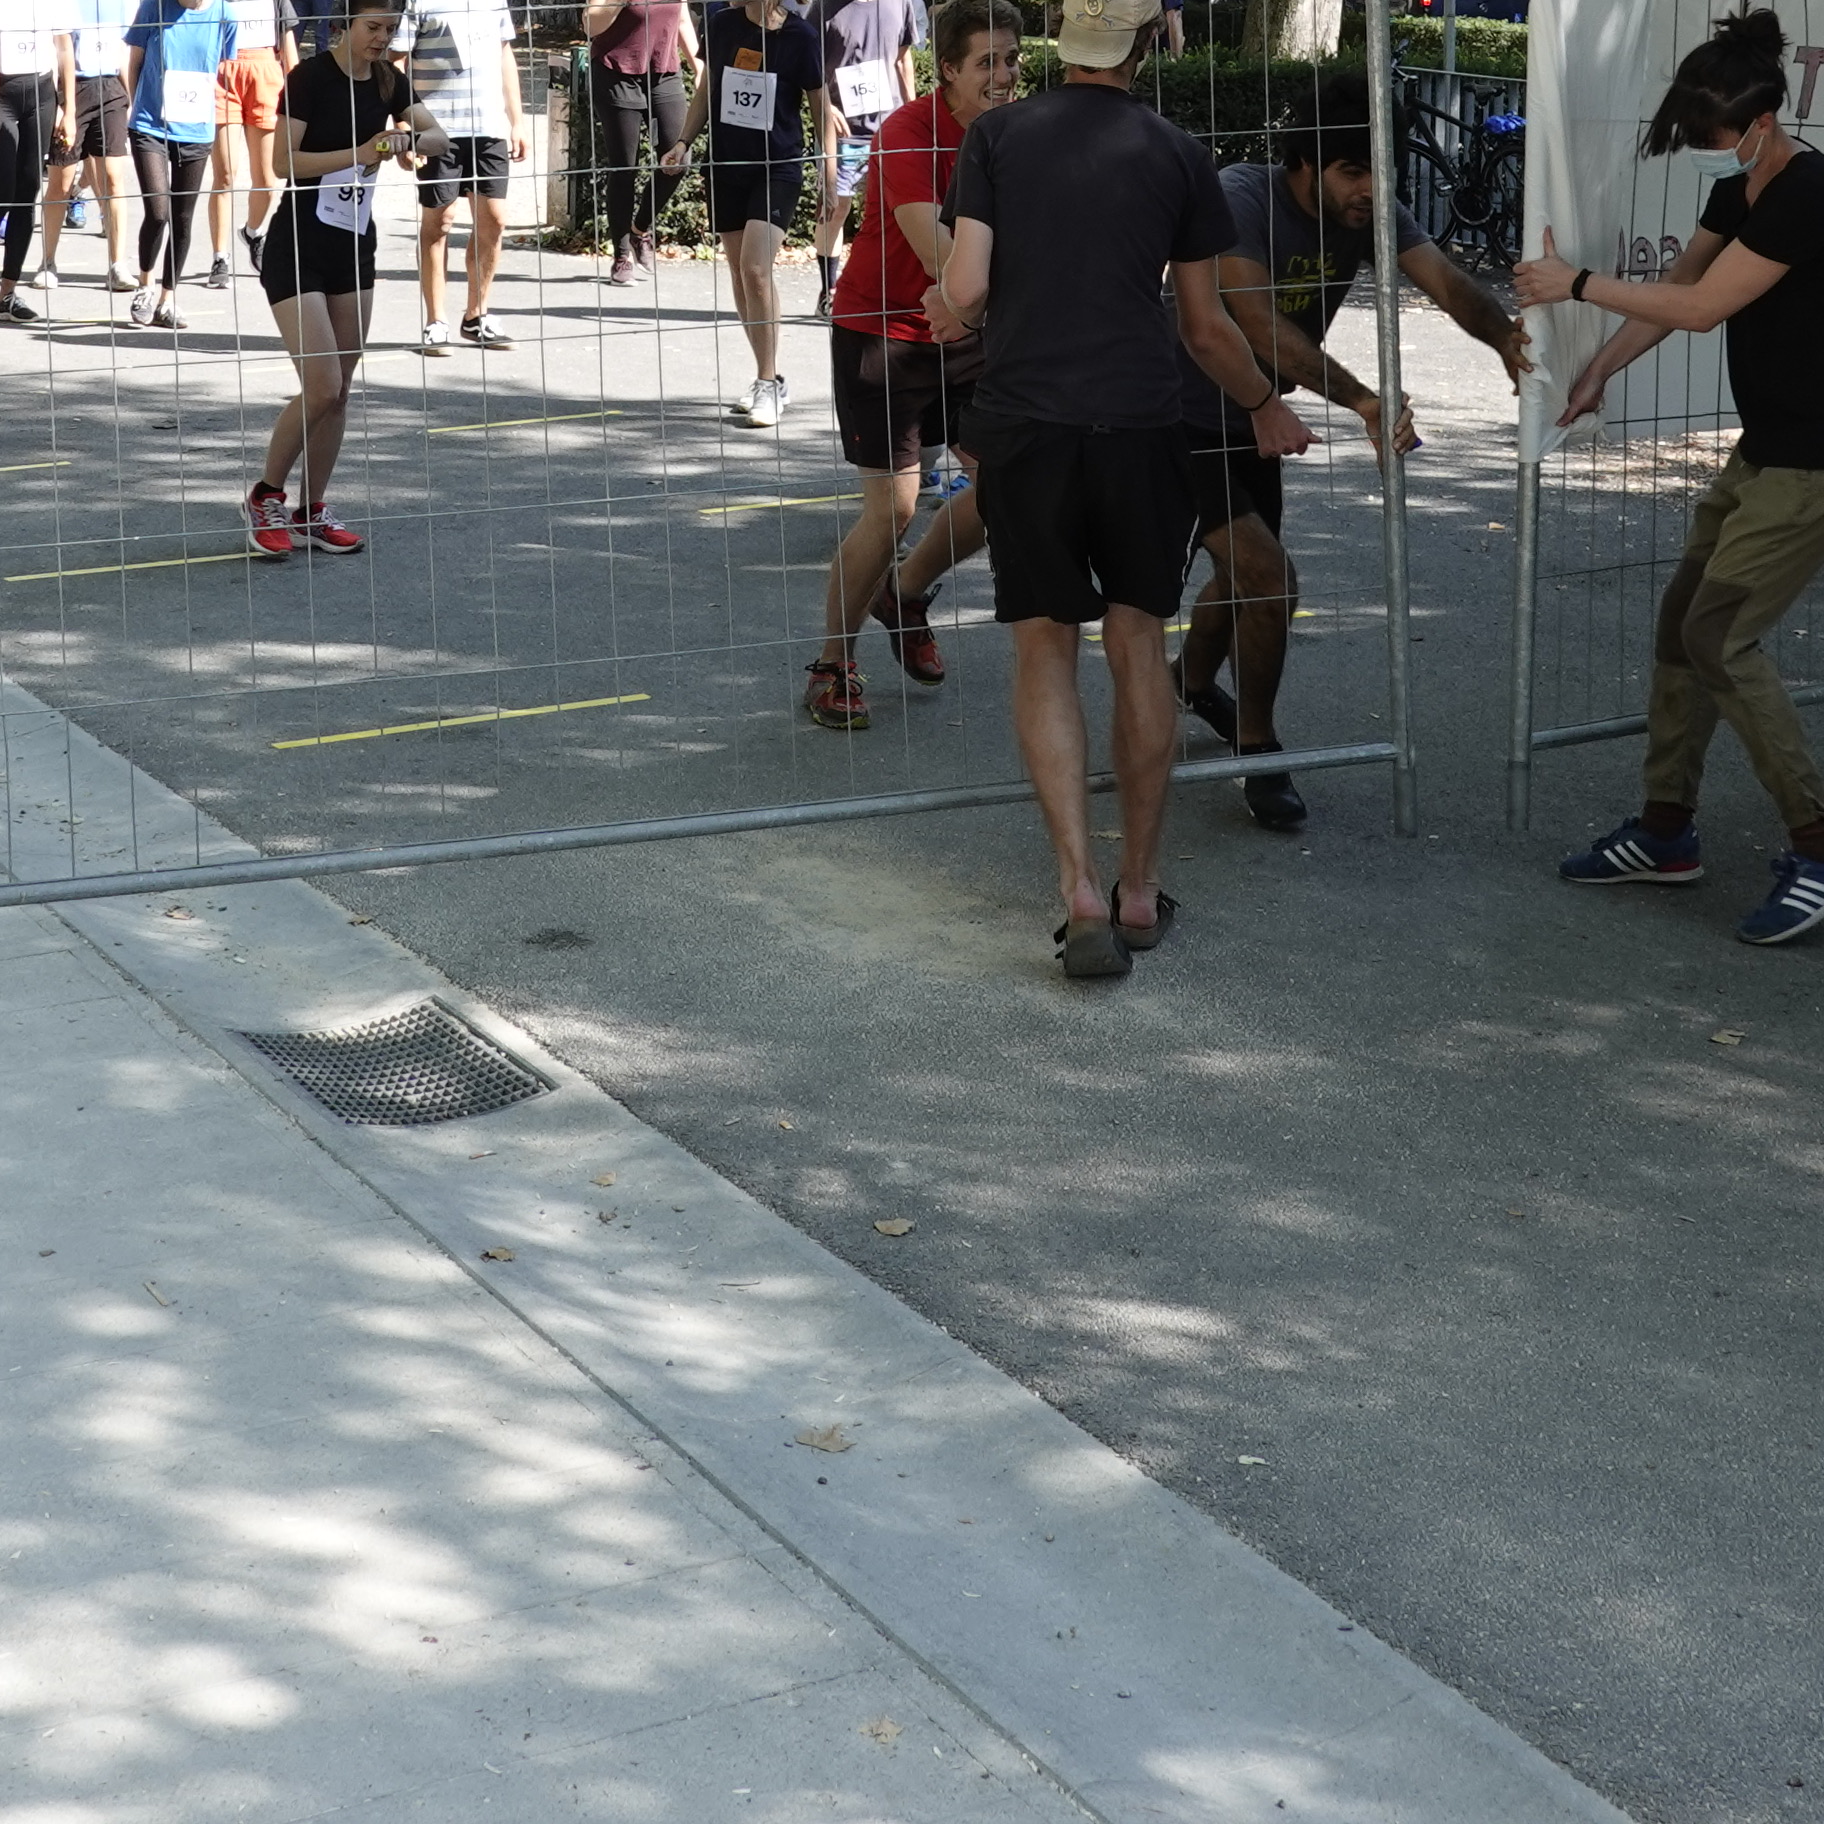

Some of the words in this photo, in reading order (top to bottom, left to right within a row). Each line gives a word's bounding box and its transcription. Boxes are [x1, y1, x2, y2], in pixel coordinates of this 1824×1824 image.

[18, 42, 35, 54] 97
[179, 90, 197, 103] 92
[733, 90, 762, 108] 137
